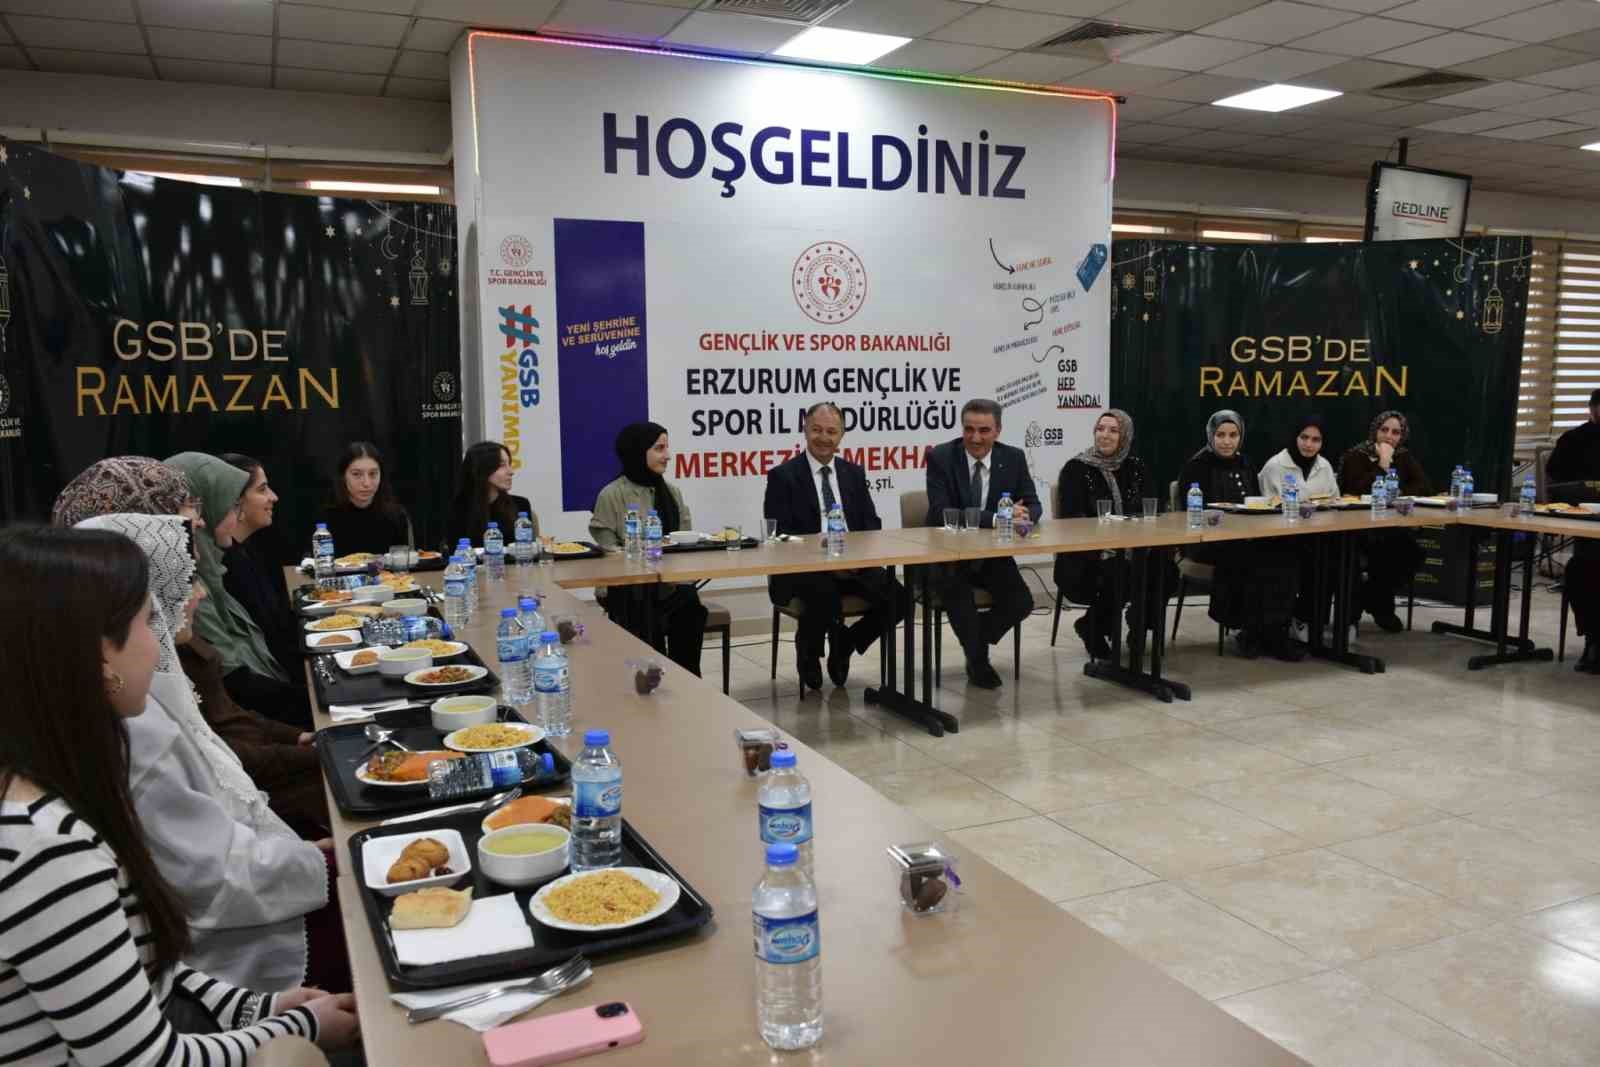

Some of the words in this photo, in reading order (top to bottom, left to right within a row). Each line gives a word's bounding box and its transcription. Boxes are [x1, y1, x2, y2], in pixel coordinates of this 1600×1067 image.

[603, 112, 1027, 198] HOŞGELDİNİZ
[1392, 200, 1449, 219] REDLINE
[567, 319, 590, 334] YENİ
[592, 316, 637, 333] ŞEHRİNE
[562, 336, 576, 346] VE
[577, 326, 640, 345] SERÜVENİNE
[699, 330, 778, 356] GENÇLİK
[783, 334, 805, 351] VE
[809, 335, 856, 352] SPOR
[860, 332, 950, 352] BAKANLIĞI
[1057, 359, 1078, 373] GSB
[686, 367, 816, 395] ERZURUM
[822, 362, 927, 400] GENÇLİK
[931, 367, 961, 392] VE
[1057, 376, 1076, 391] HEP
[1057, 394, 1102, 409] YANINDA!
[691, 408, 762, 436] SPOR
[770, 402, 791, 434] İL
[1043, 428, 1063, 440] GSB
